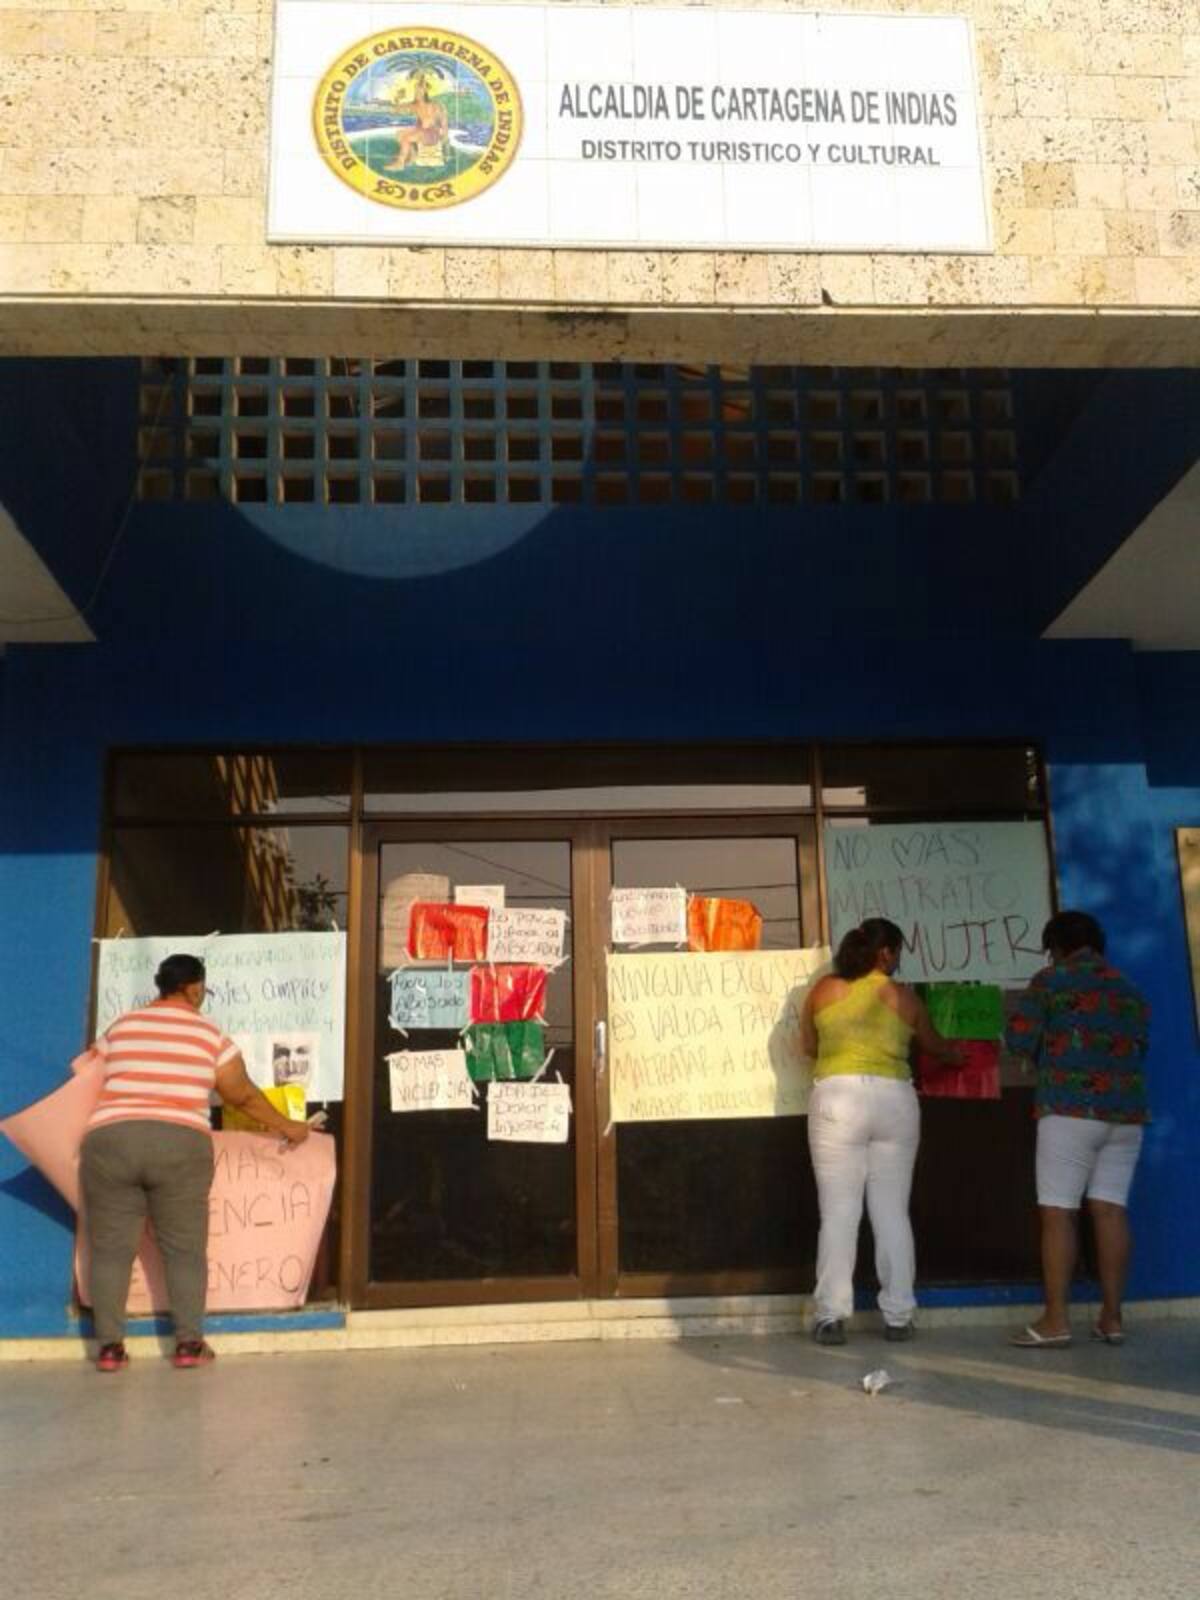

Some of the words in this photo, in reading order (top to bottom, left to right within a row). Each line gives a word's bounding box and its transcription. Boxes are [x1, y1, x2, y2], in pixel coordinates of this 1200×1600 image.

[343, 53, 371, 79] DE
[372, 36, 493, 77] CARTAGENA
[490, 78, 510, 106] DE
[558, 83, 670, 120] ALCALDIA
[675, 86, 705, 121] DE
[710, 86, 846, 124] CARTAGENA
[850, 91, 880, 125] DE
[885, 91, 958, 127] INDIAS
[323, 80, 358, 171] DISTRITO
[480, 109, 513, 177] INDIAS
[581, 139, 681, 161] DISTRITO
[687, 140, 801, 163] TURISTICO
[807, 143, 821, 163] Y
[827, 144, 941, 166] CULTURAL
[833, 833, 869, 871] NO
[900, 914, 1045, 977] MUJER
[609, 961, 714, 1004] NINGUNA
[647, 1002, 724, 1042] VALIDA
